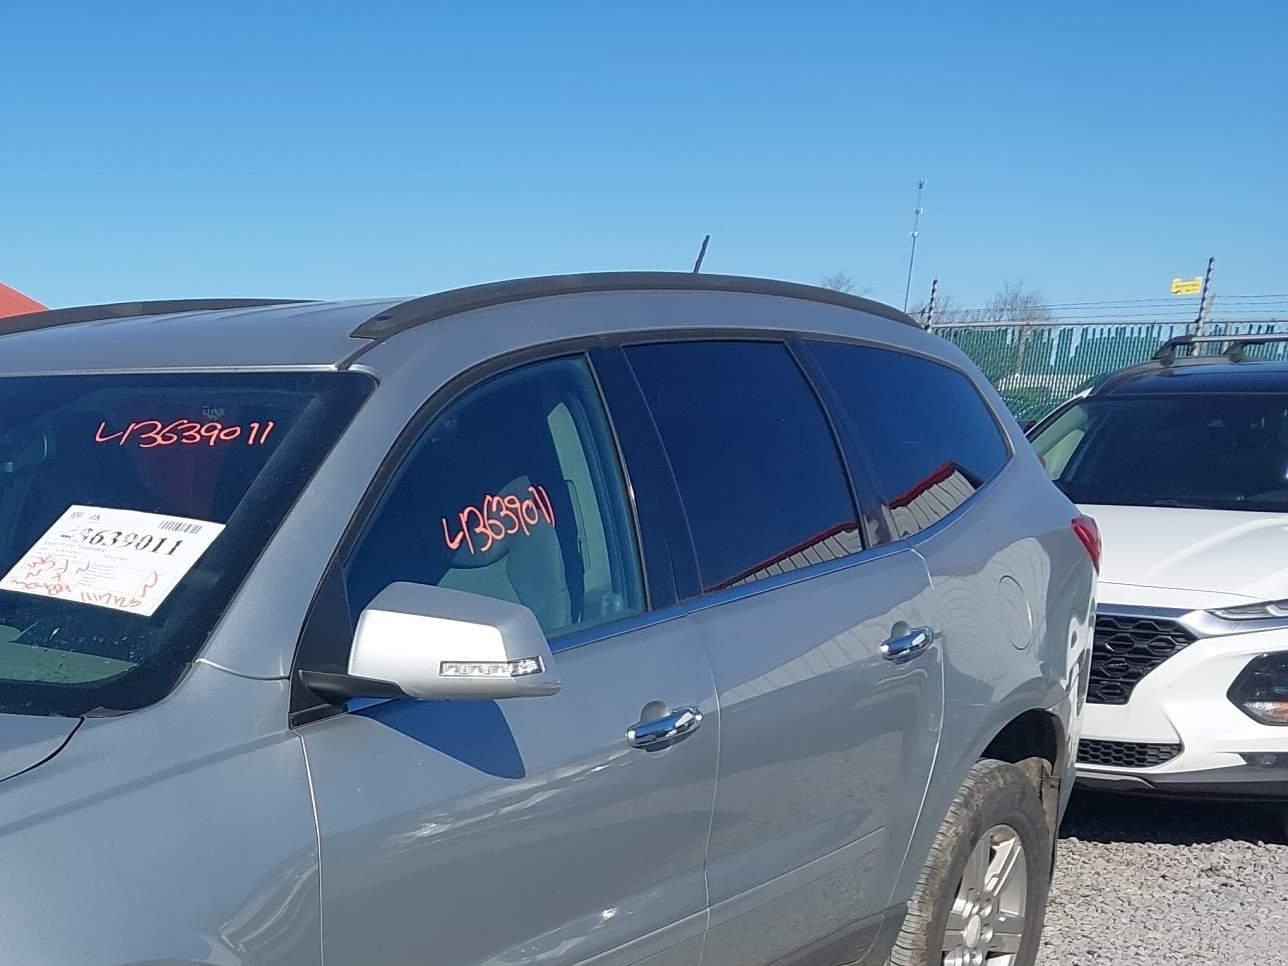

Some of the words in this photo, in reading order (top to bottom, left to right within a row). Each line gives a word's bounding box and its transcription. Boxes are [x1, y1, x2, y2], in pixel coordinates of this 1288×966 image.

[95, 419, 275, 448] 43639011
[441, 485, 556, 555] 43639011
[61, 526, 184, 557] 3639011
